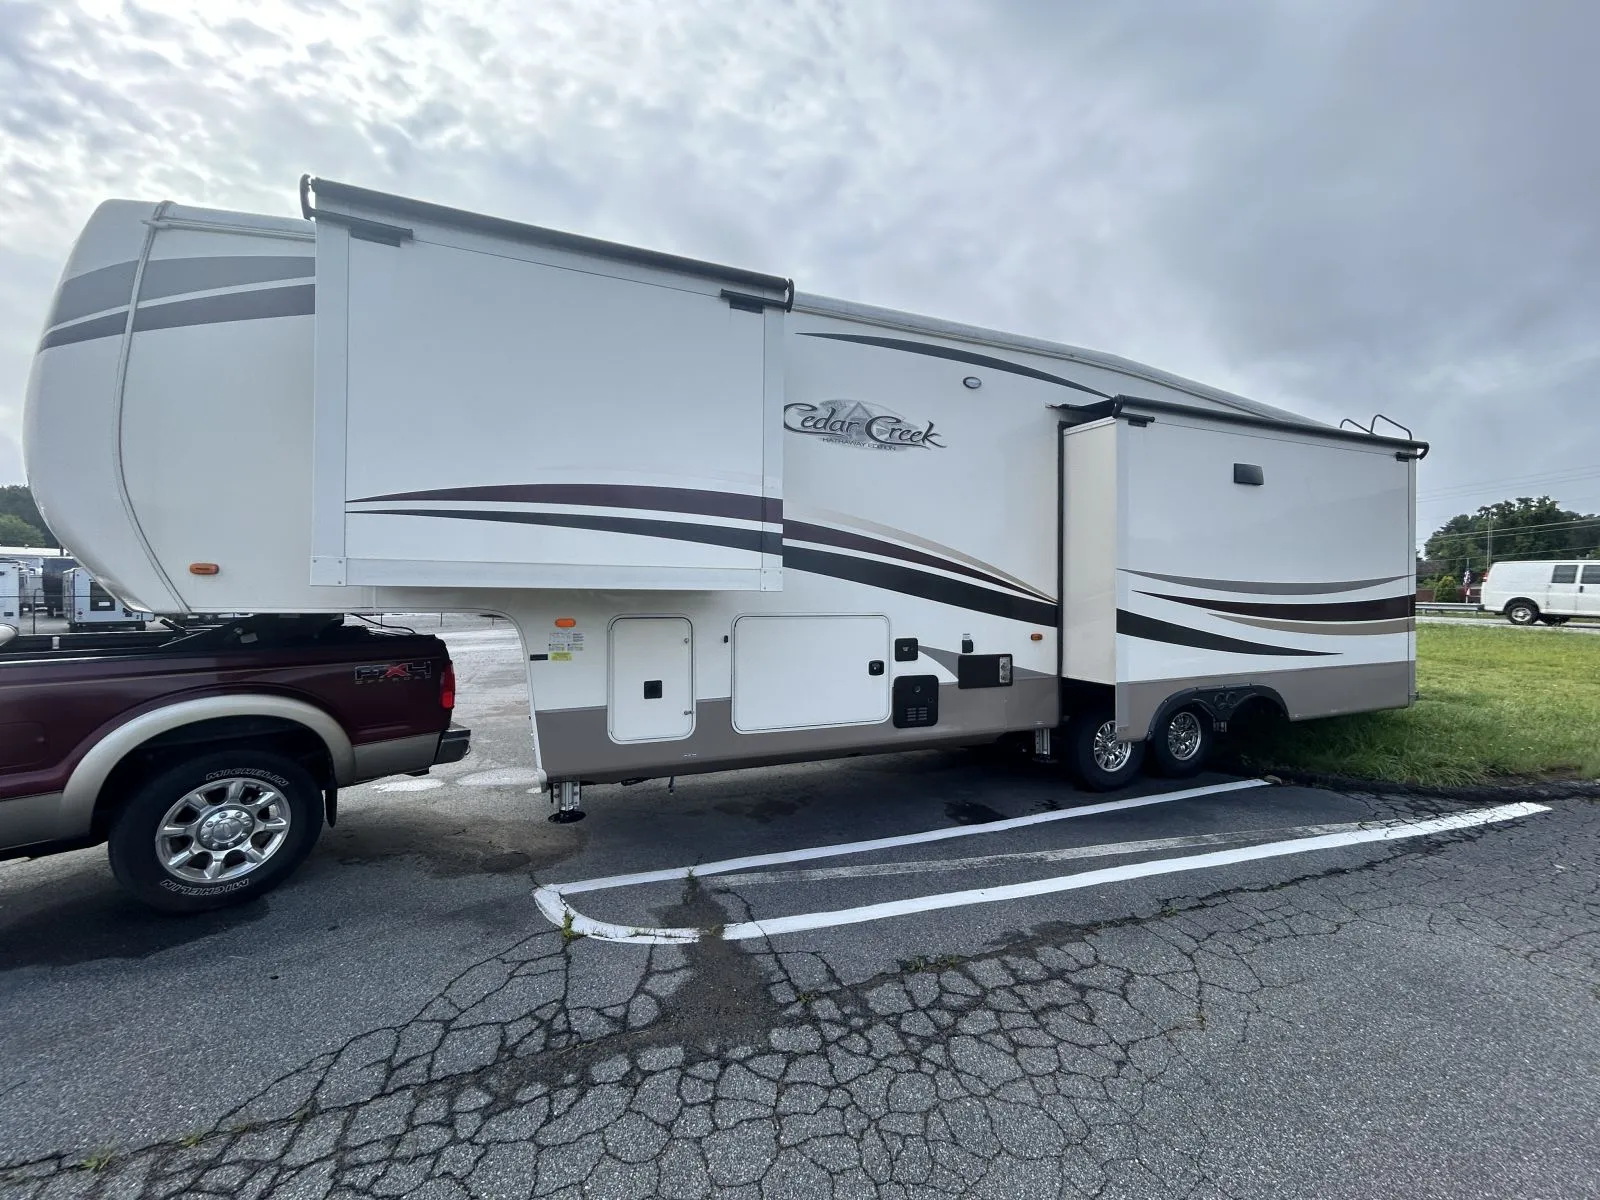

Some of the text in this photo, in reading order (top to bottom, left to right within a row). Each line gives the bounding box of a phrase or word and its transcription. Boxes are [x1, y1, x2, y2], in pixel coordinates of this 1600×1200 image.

[784, 403, 947, 450] Cedar Creek
[822, 437, 866, 448] HATHAWAY
[355, 661, 431, 681] FX4
[205, 768, 289, 787] MICHELIN
[160, 878, 249, 896] MICHELIN
